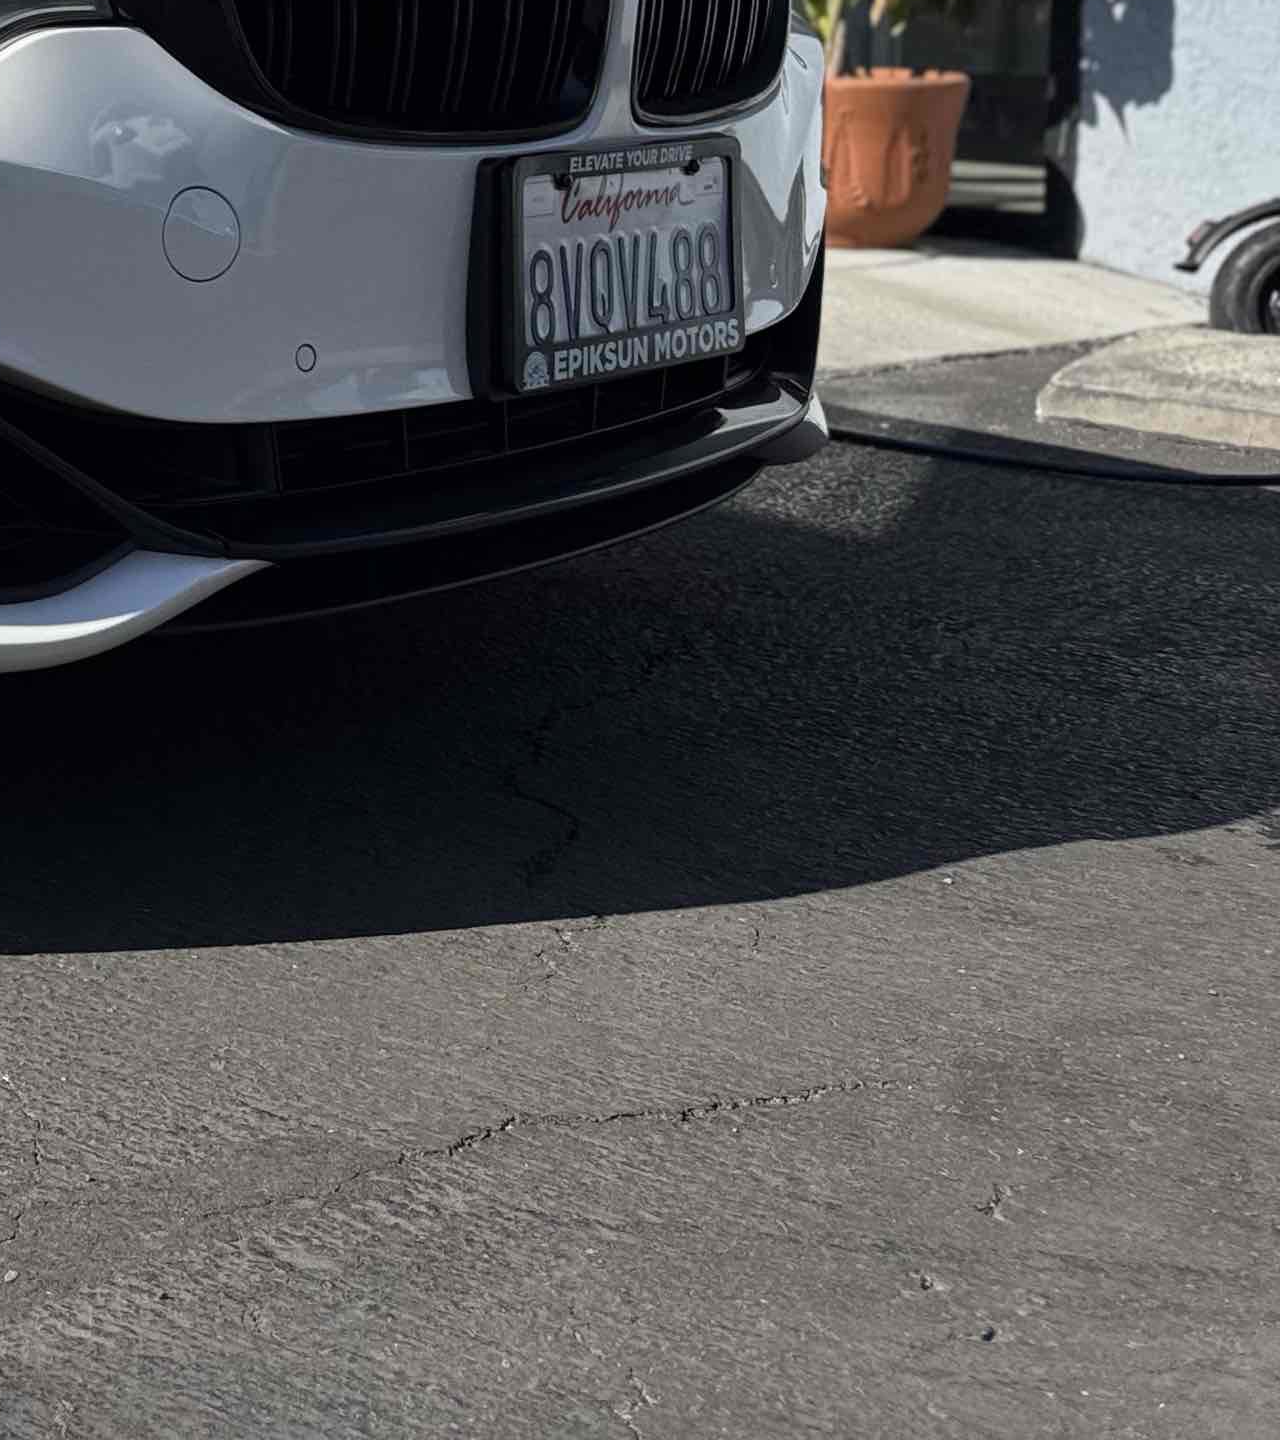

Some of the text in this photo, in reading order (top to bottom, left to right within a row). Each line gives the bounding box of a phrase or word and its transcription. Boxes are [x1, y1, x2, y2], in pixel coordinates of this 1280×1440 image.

[569, 144, 694, 173] ELEVATE YOUR DRIVE
[559, 174, 696, 233] California
[553, 319, 740, 381] EPIKSUN MOTORS
